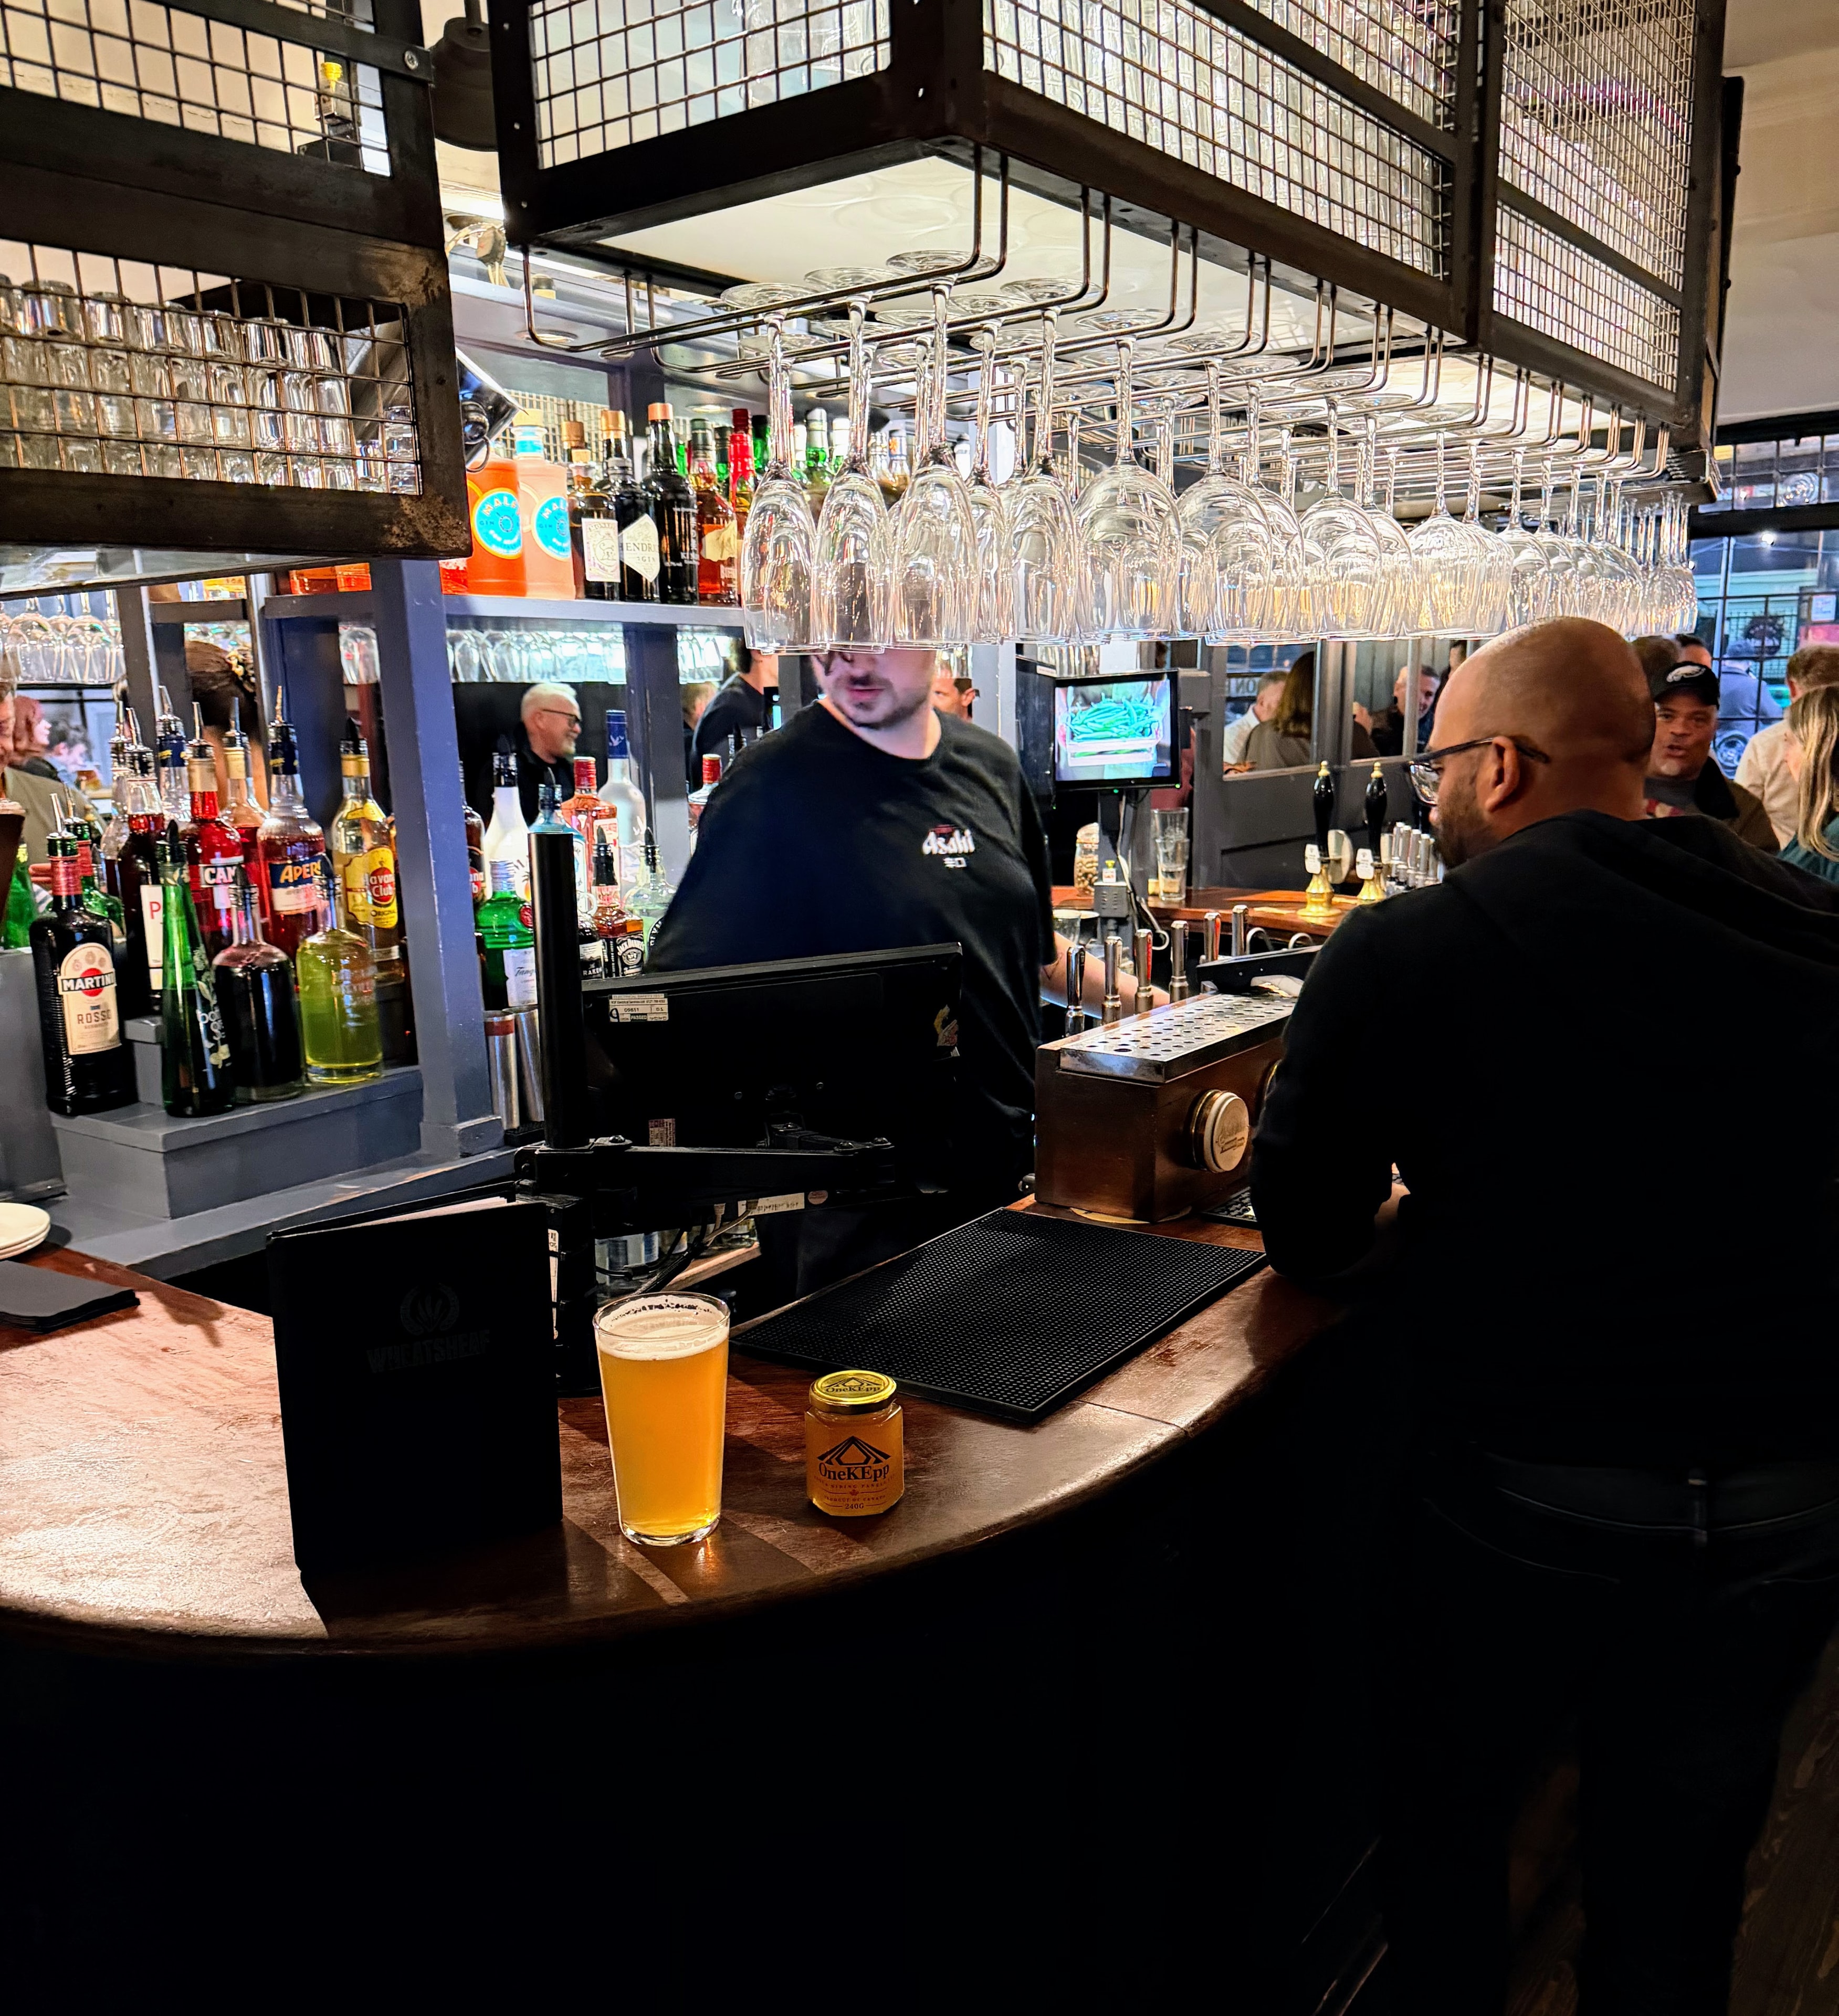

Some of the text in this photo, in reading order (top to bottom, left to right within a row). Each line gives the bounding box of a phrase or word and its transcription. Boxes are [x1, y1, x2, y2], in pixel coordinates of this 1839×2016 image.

[922, 829, 975, 855] Asahi
[366, 1330, 490, 1373] WHEATSHEAF
[819, 1462, 889, 1482] OneKEpp
